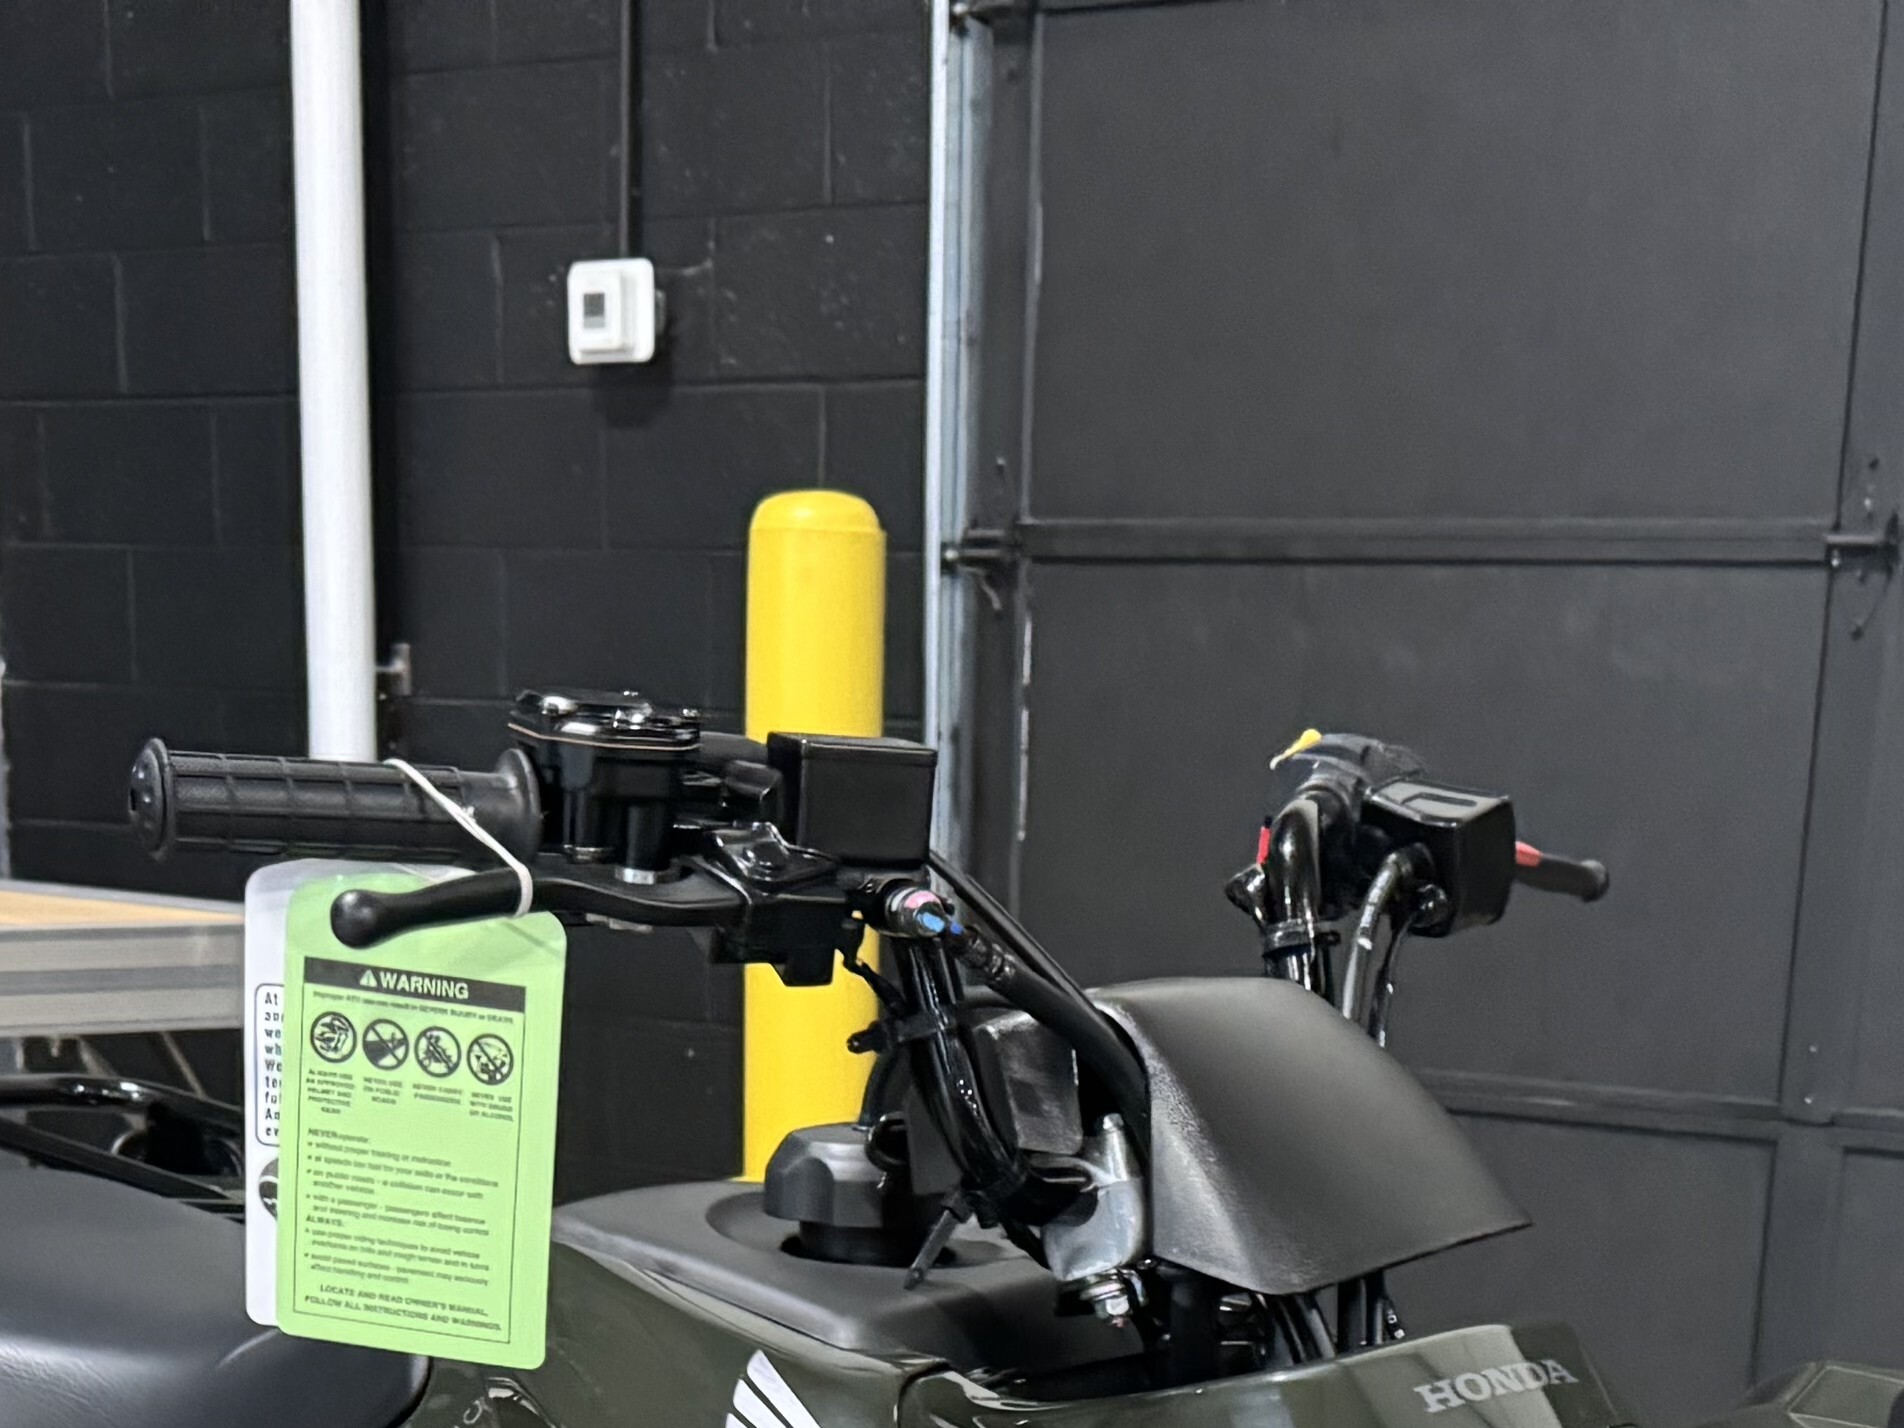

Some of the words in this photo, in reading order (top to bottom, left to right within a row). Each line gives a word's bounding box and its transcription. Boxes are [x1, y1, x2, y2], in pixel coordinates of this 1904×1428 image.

[378, 971, 469, 1000] WARNING
[264, 1011, 284, 1023] an
[1413, 1359, 1579, 1413] HONDA
